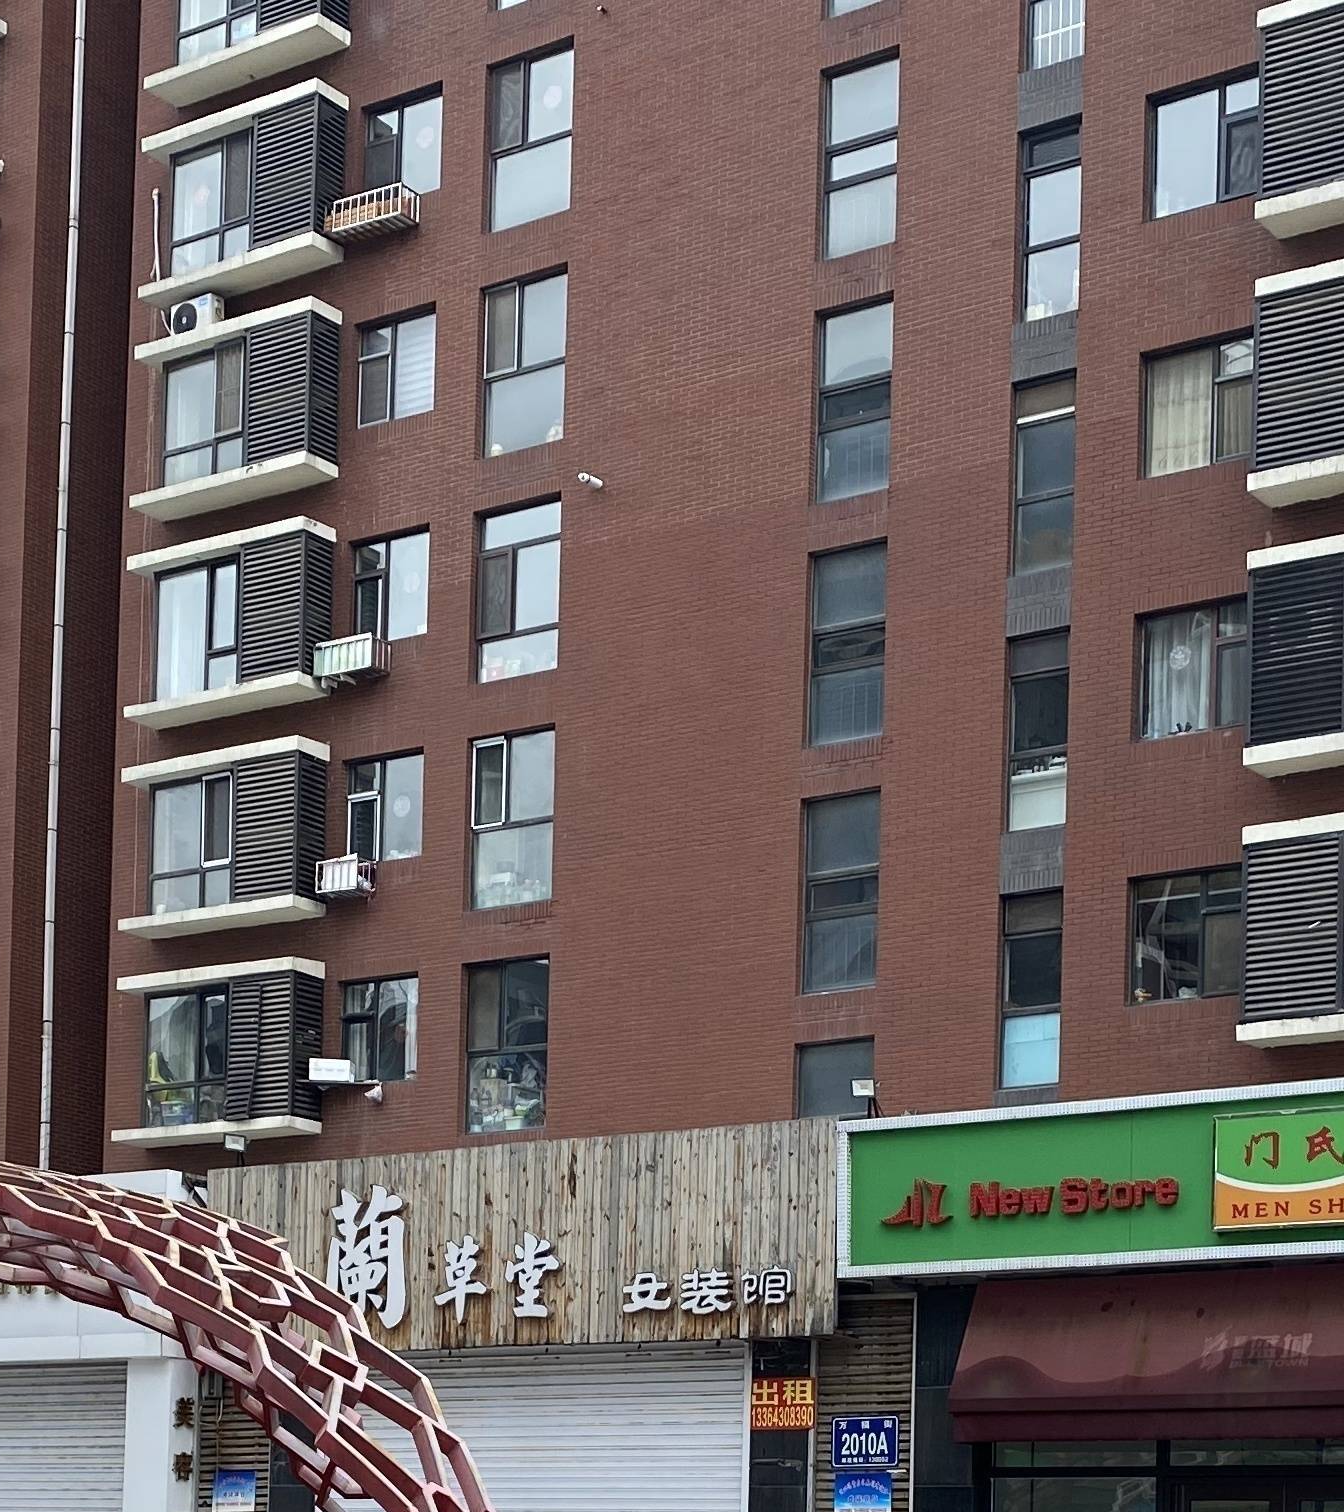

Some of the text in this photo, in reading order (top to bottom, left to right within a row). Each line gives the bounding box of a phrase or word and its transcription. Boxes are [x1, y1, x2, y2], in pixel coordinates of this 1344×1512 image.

[1244, 1126, 1344, 1170] 门氏
[970, 1176, 1180, 1219] New Store
[1232, 1199, 1290, 1219] MEN
[751, 1379, 815, 1405] 出租
[751, 1405, 814, 1427] 13364308390
[840, 1431, 889, 1456] 2010A
